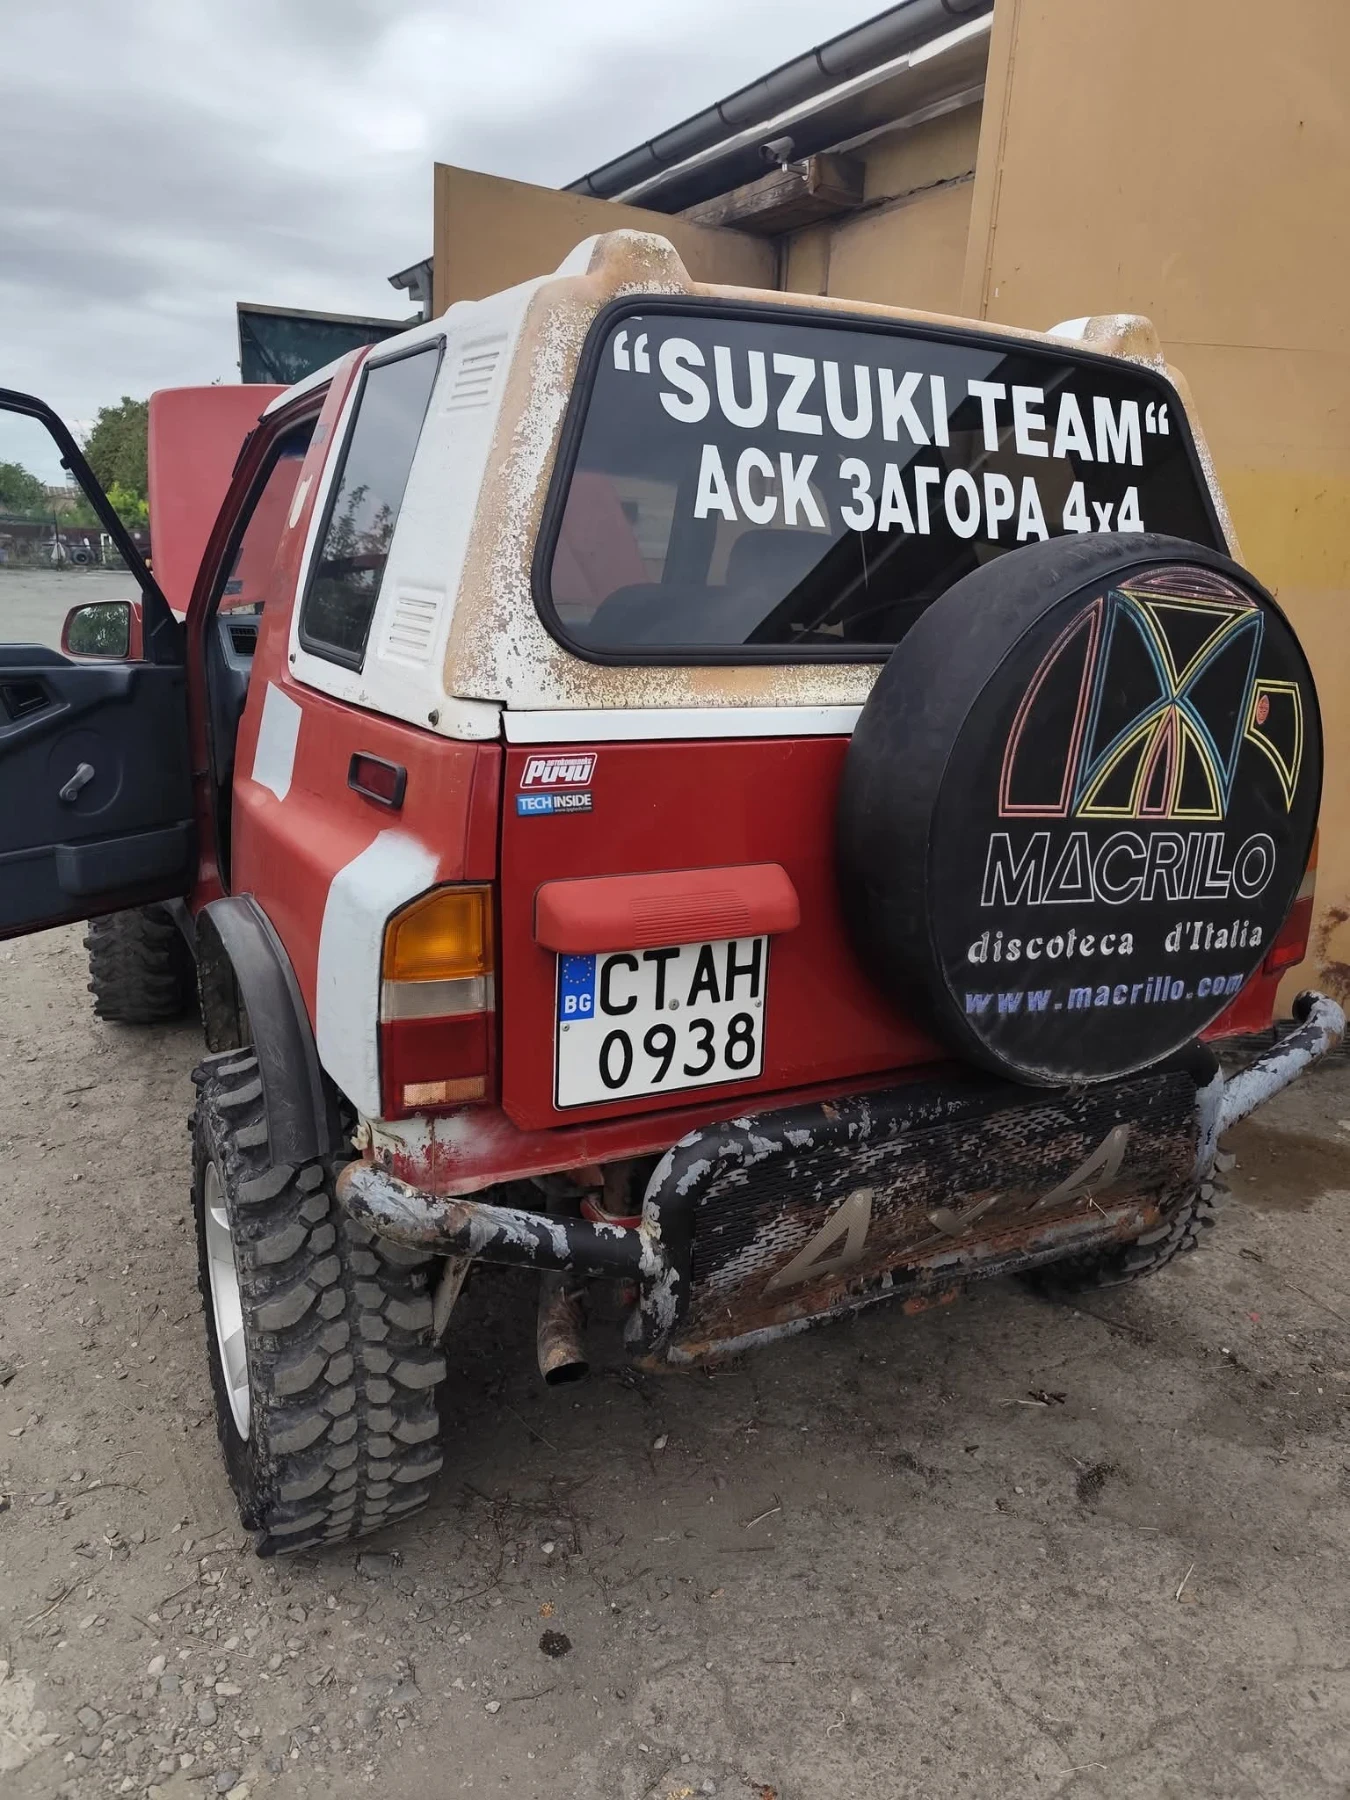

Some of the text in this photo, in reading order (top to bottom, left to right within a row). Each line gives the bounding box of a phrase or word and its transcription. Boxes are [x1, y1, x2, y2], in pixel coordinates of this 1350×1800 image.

[693, 444, 1145, 541] АСК ЗАГОРА 4x4
[519, 793, 592, 811] TECH INSIDE
[980, 831, 1276, 907] MACRILLO
[967, 920, 1263, 963] discoteca d'Italia
[563, 994, 592, 1014] BG
[965, 972, 1245, 1014] www.macrillo.com
[599, 1012, 756, 1090] 0938
